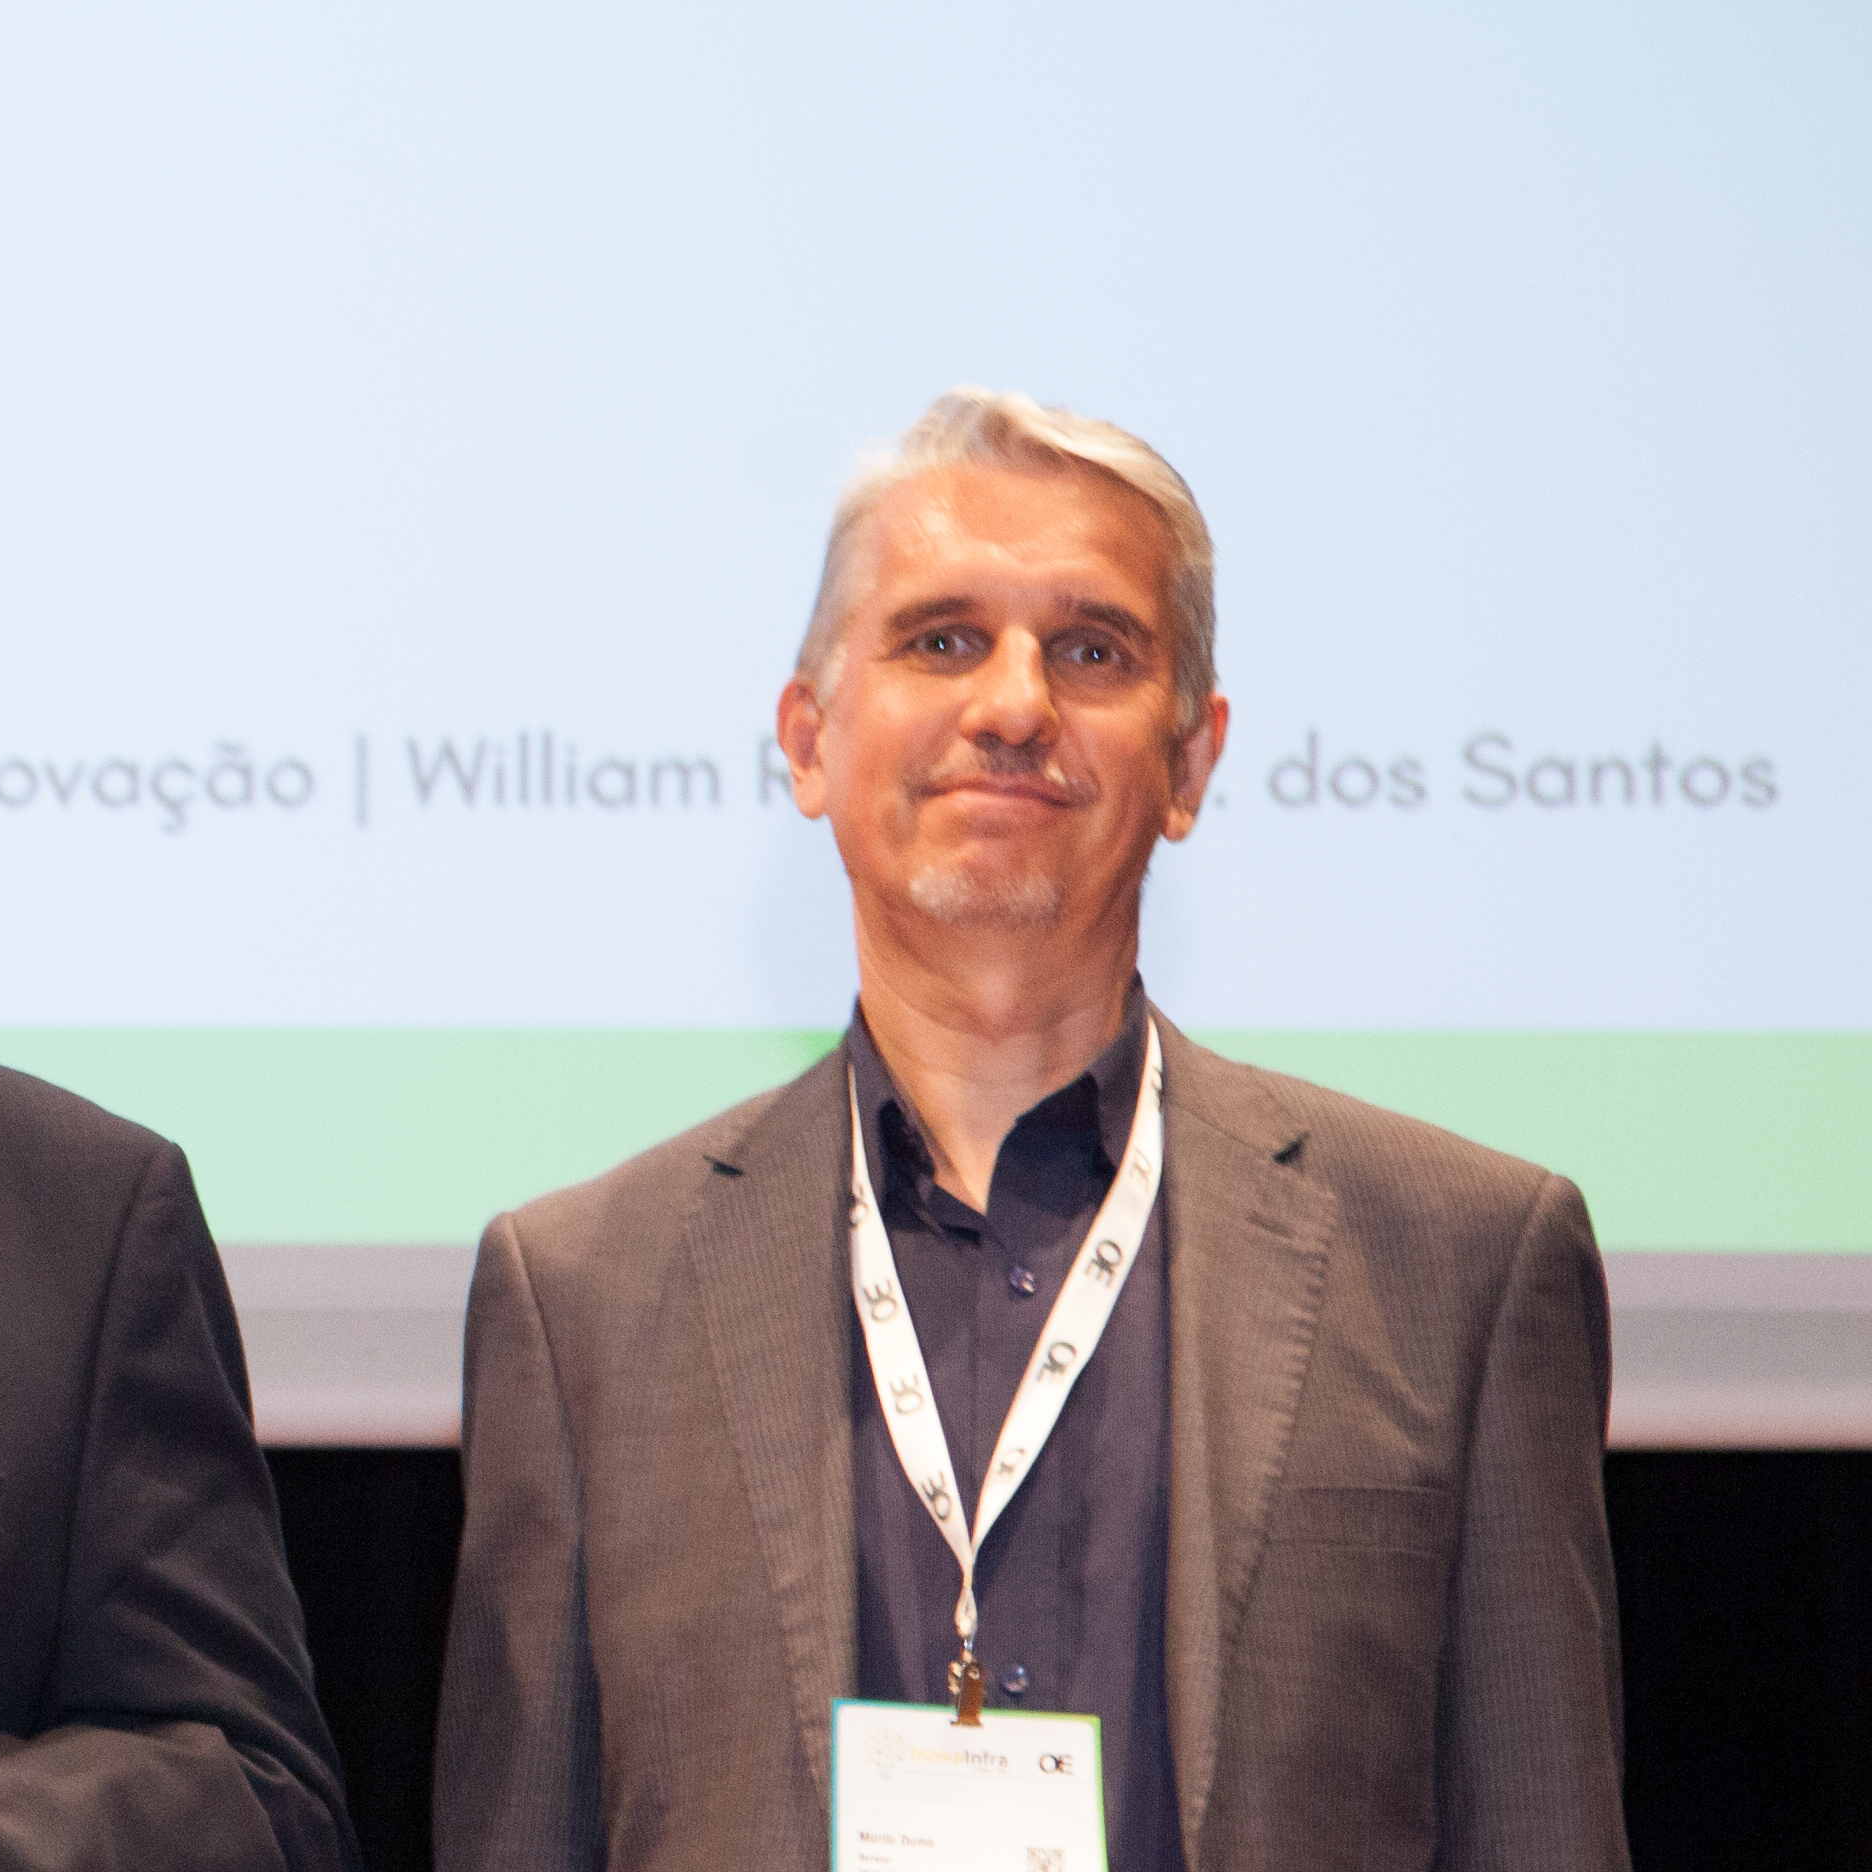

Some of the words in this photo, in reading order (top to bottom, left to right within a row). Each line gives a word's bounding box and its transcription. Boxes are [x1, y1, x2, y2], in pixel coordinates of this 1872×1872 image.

[404, 727, 722, 809] William
[1265, 725, 1428, 809] dos
[1459, 727, 1780, 811] Santos
